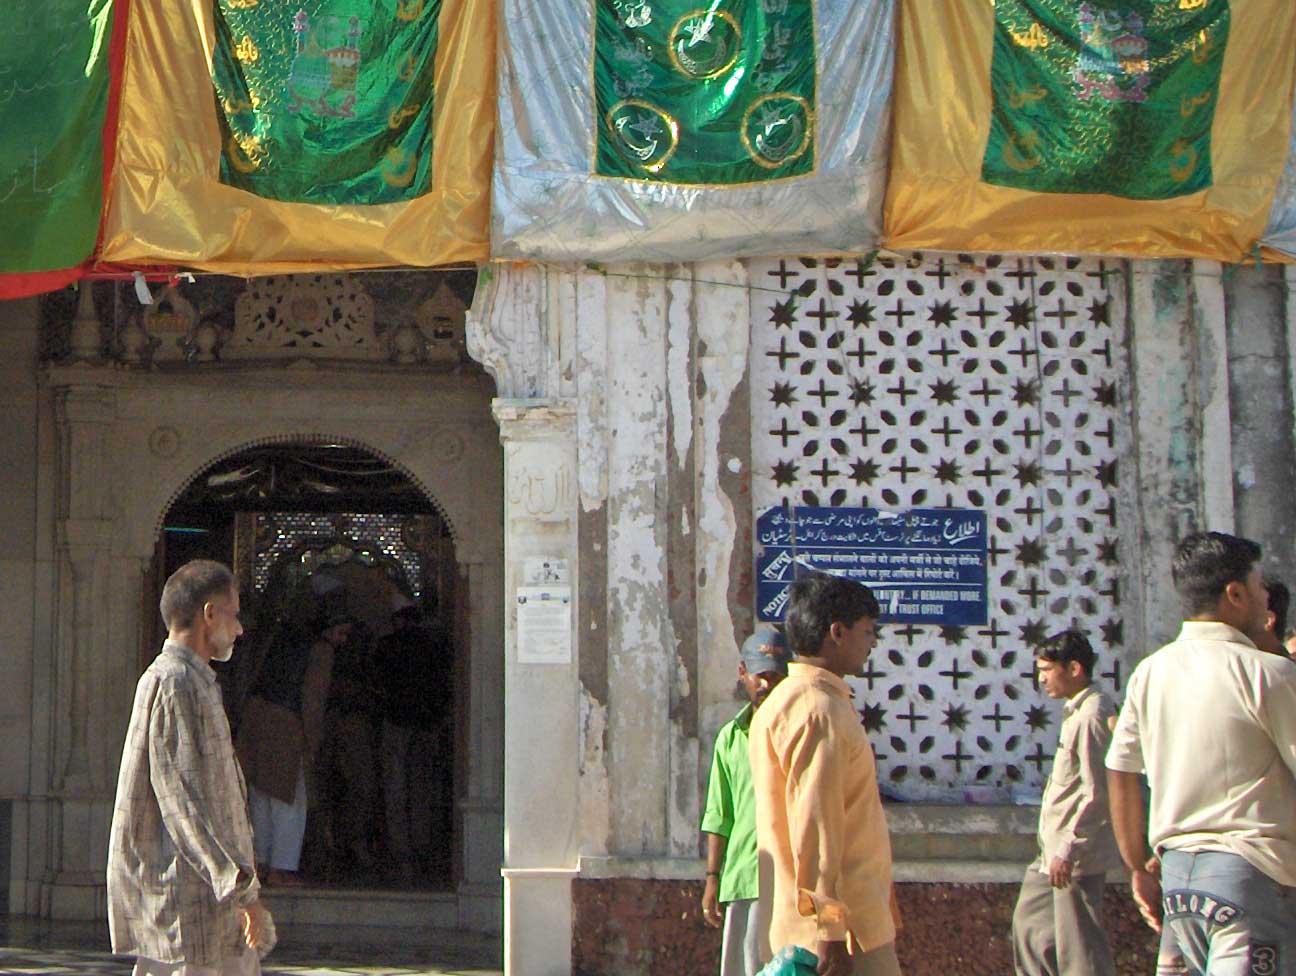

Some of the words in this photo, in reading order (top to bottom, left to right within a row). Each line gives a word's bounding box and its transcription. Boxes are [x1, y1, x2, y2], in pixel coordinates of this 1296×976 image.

[943, 518, 980, 541] اطلاع
[762, 551, 793, 578] सूचना
[913, 590, 919, 600] IF
[921, 590, 958, 601] DEMANDED
[899, 604, 919, 614] TRUST
[921, 604, 944, 614] OFFICE
